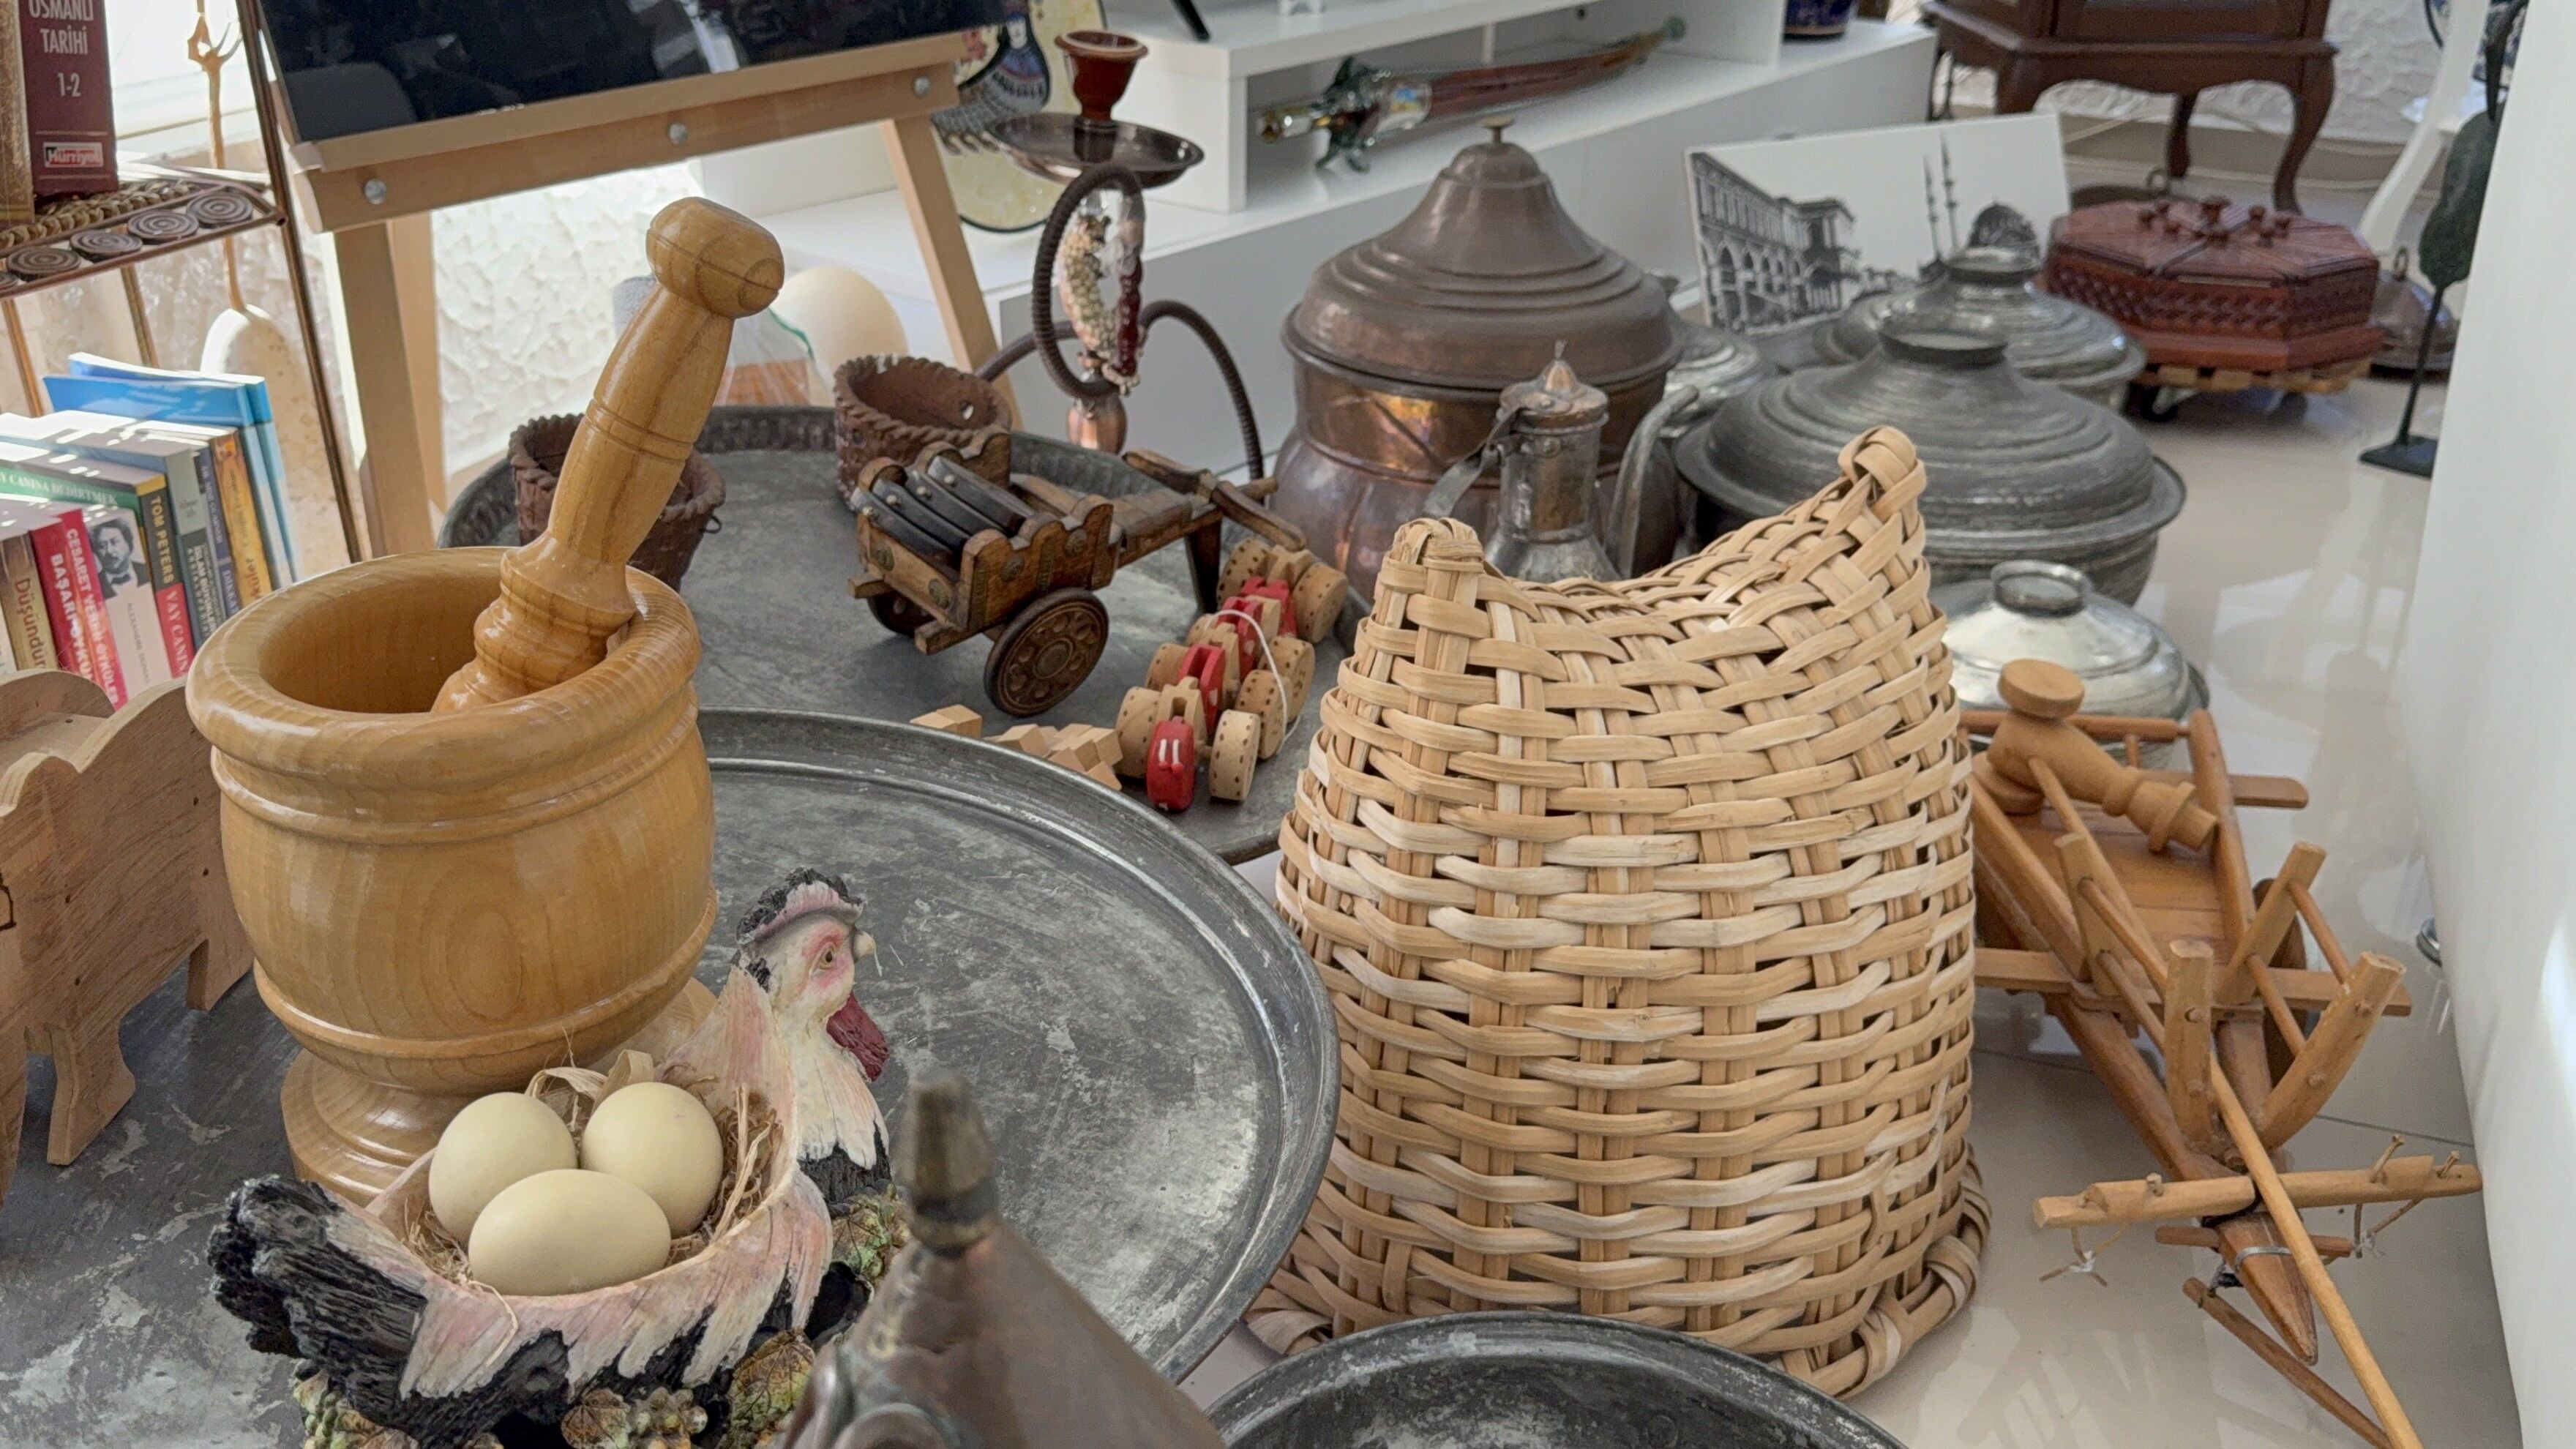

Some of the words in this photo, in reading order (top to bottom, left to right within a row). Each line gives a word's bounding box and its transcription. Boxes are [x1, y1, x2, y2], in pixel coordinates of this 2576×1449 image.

[29, 0, 94, 21] OSMANLI
[40, 25, 89, 55] TARİHİ
[58, 72, 81, 97] 1-2
[151, 495, 165, 528] TOM
[155, 530, 175, 584] PETERS
[50, 553, 76, 621] BAŞARI
[67, 528, 92, 591] CESARET
[83, 593, 104, 642] VEREN
[166, 591, 181, 621] VAY
